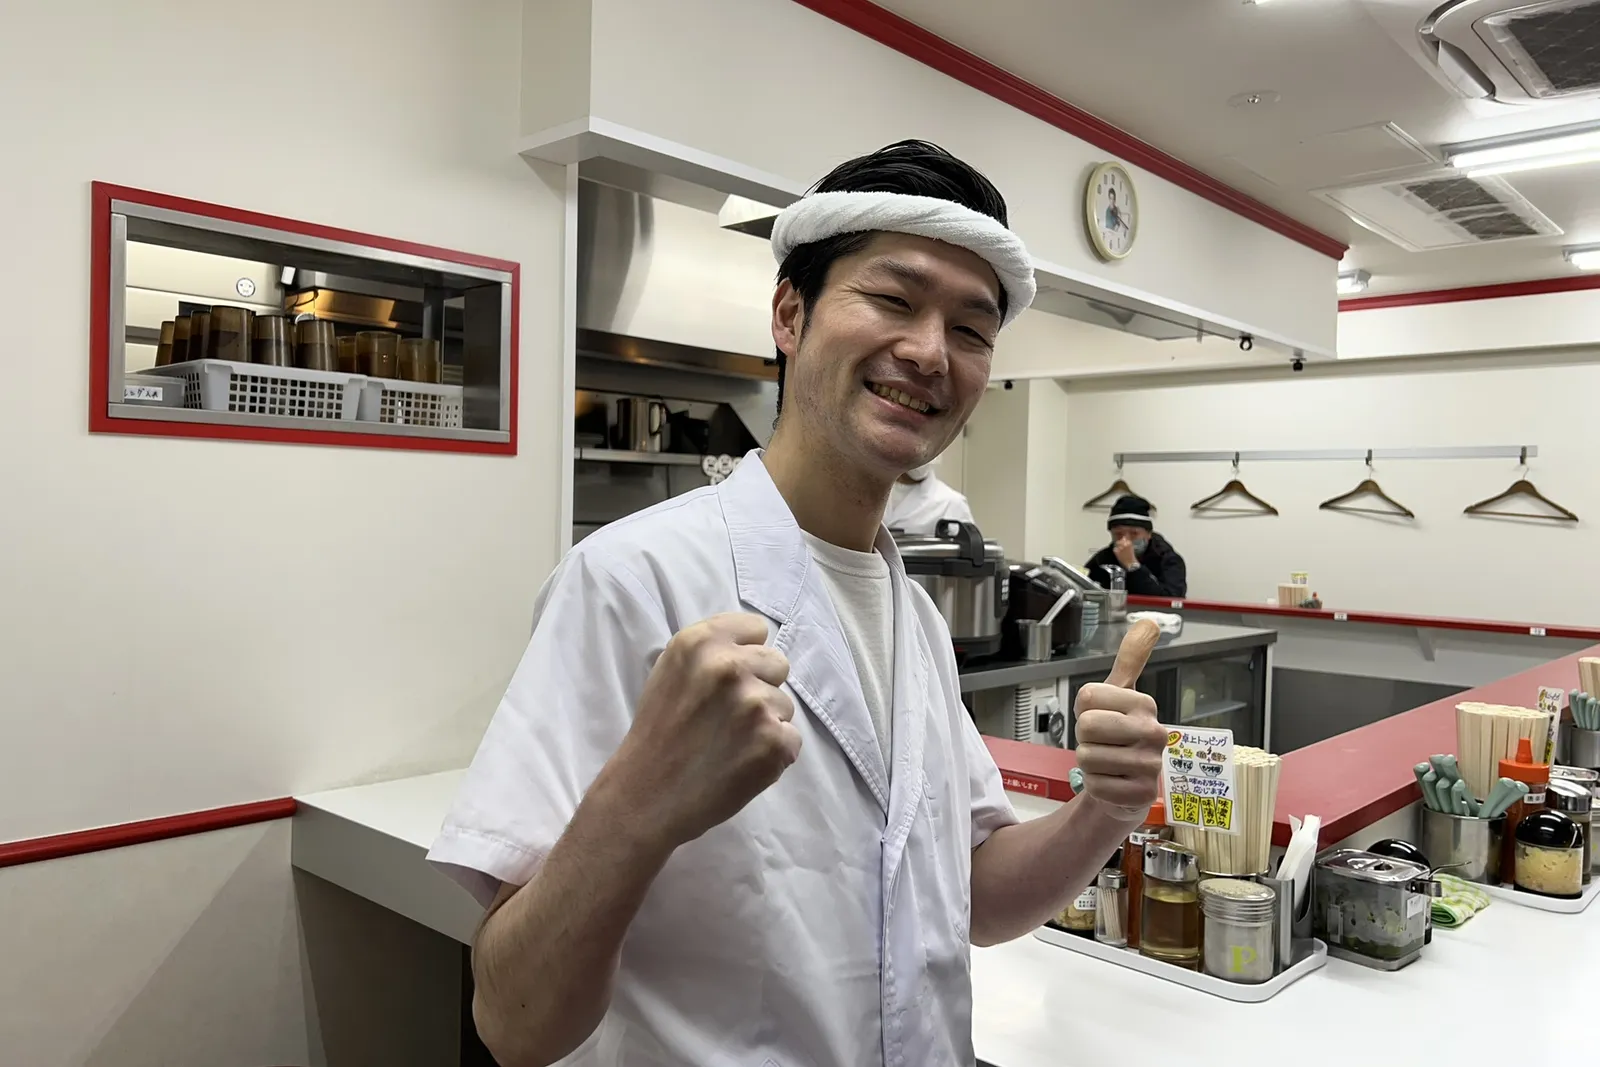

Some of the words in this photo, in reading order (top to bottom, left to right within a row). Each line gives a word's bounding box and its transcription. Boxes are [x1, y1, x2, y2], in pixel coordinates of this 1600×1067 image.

[1182, 733, 1228, 746] 卓上トッピング
[1172, 795, 1182, 818] 油なし
[1187, 794, 1198, 822] 油少なめ
[1229, 945, 1258, 973] P
